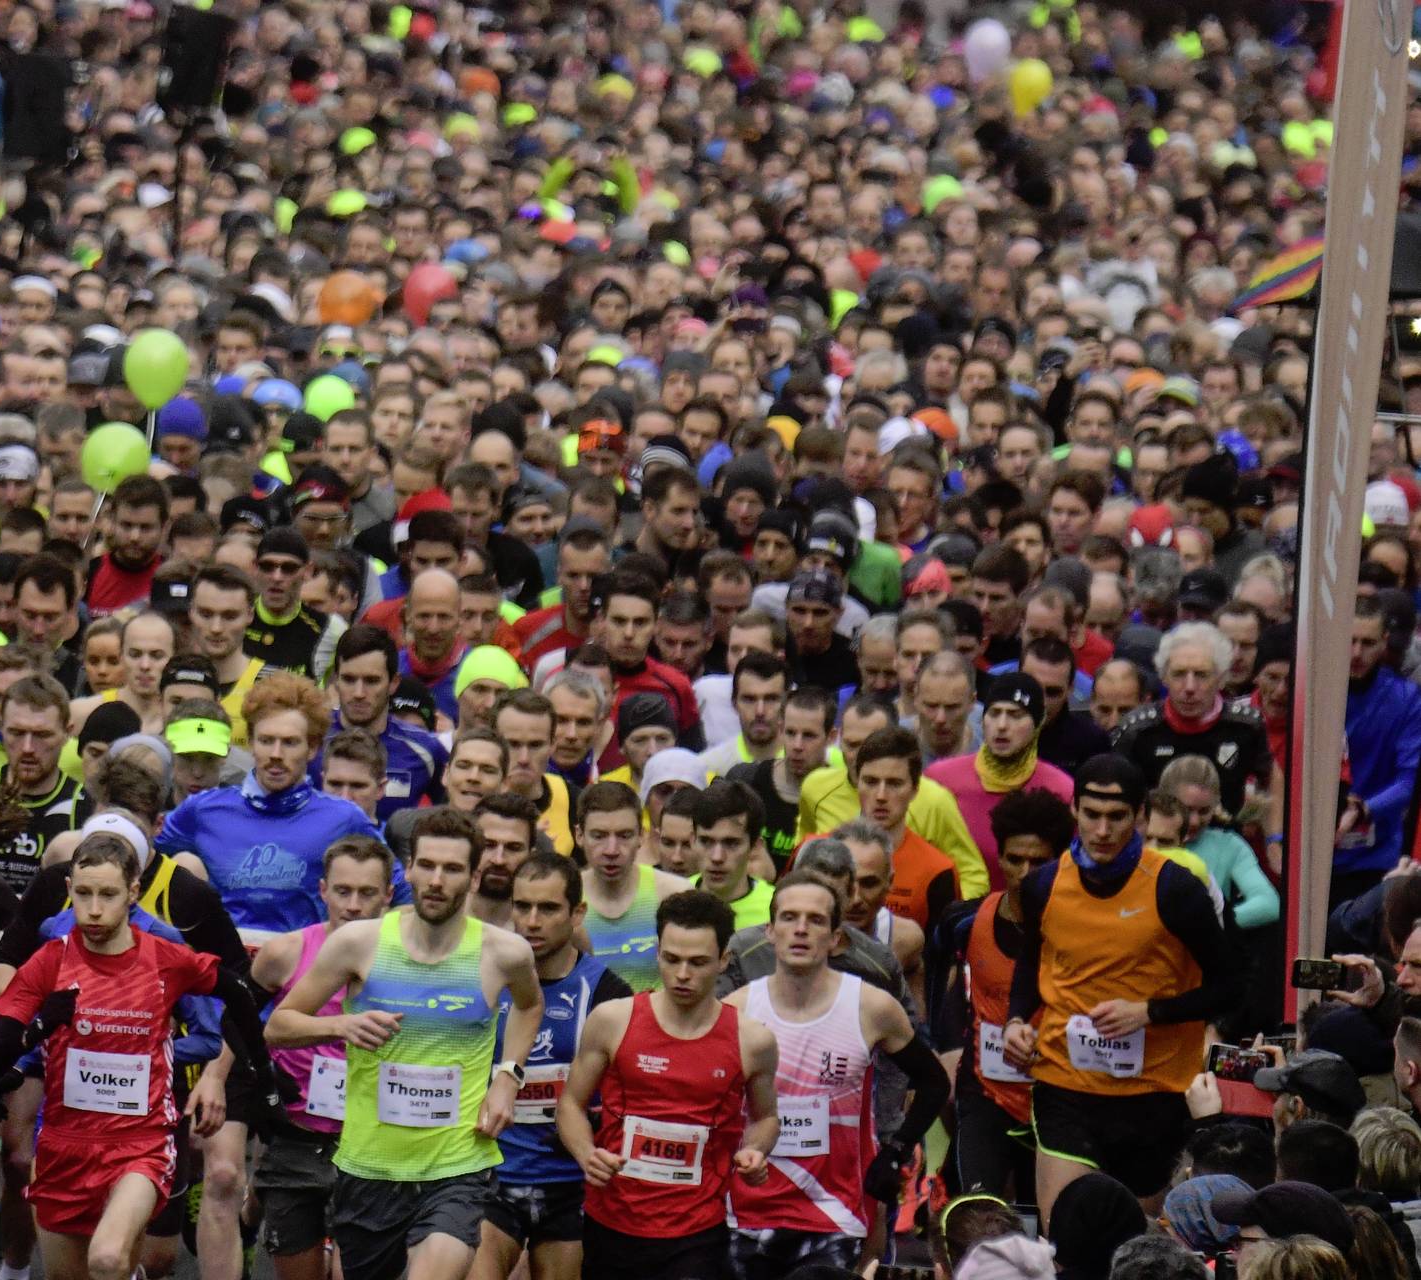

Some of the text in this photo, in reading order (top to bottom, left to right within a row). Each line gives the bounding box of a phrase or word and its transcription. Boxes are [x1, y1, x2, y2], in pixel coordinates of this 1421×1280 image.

[1079, 1034, 1130, 1050] Tobias
[79, 1071, 137, 1087] Volker
[387, 1082, 453, 1098] Thomas
[517, 1084, 556, 1100] 550
[779, 1115, 813, 1127] kas
[642, 1140, 687, 1160] 4169
